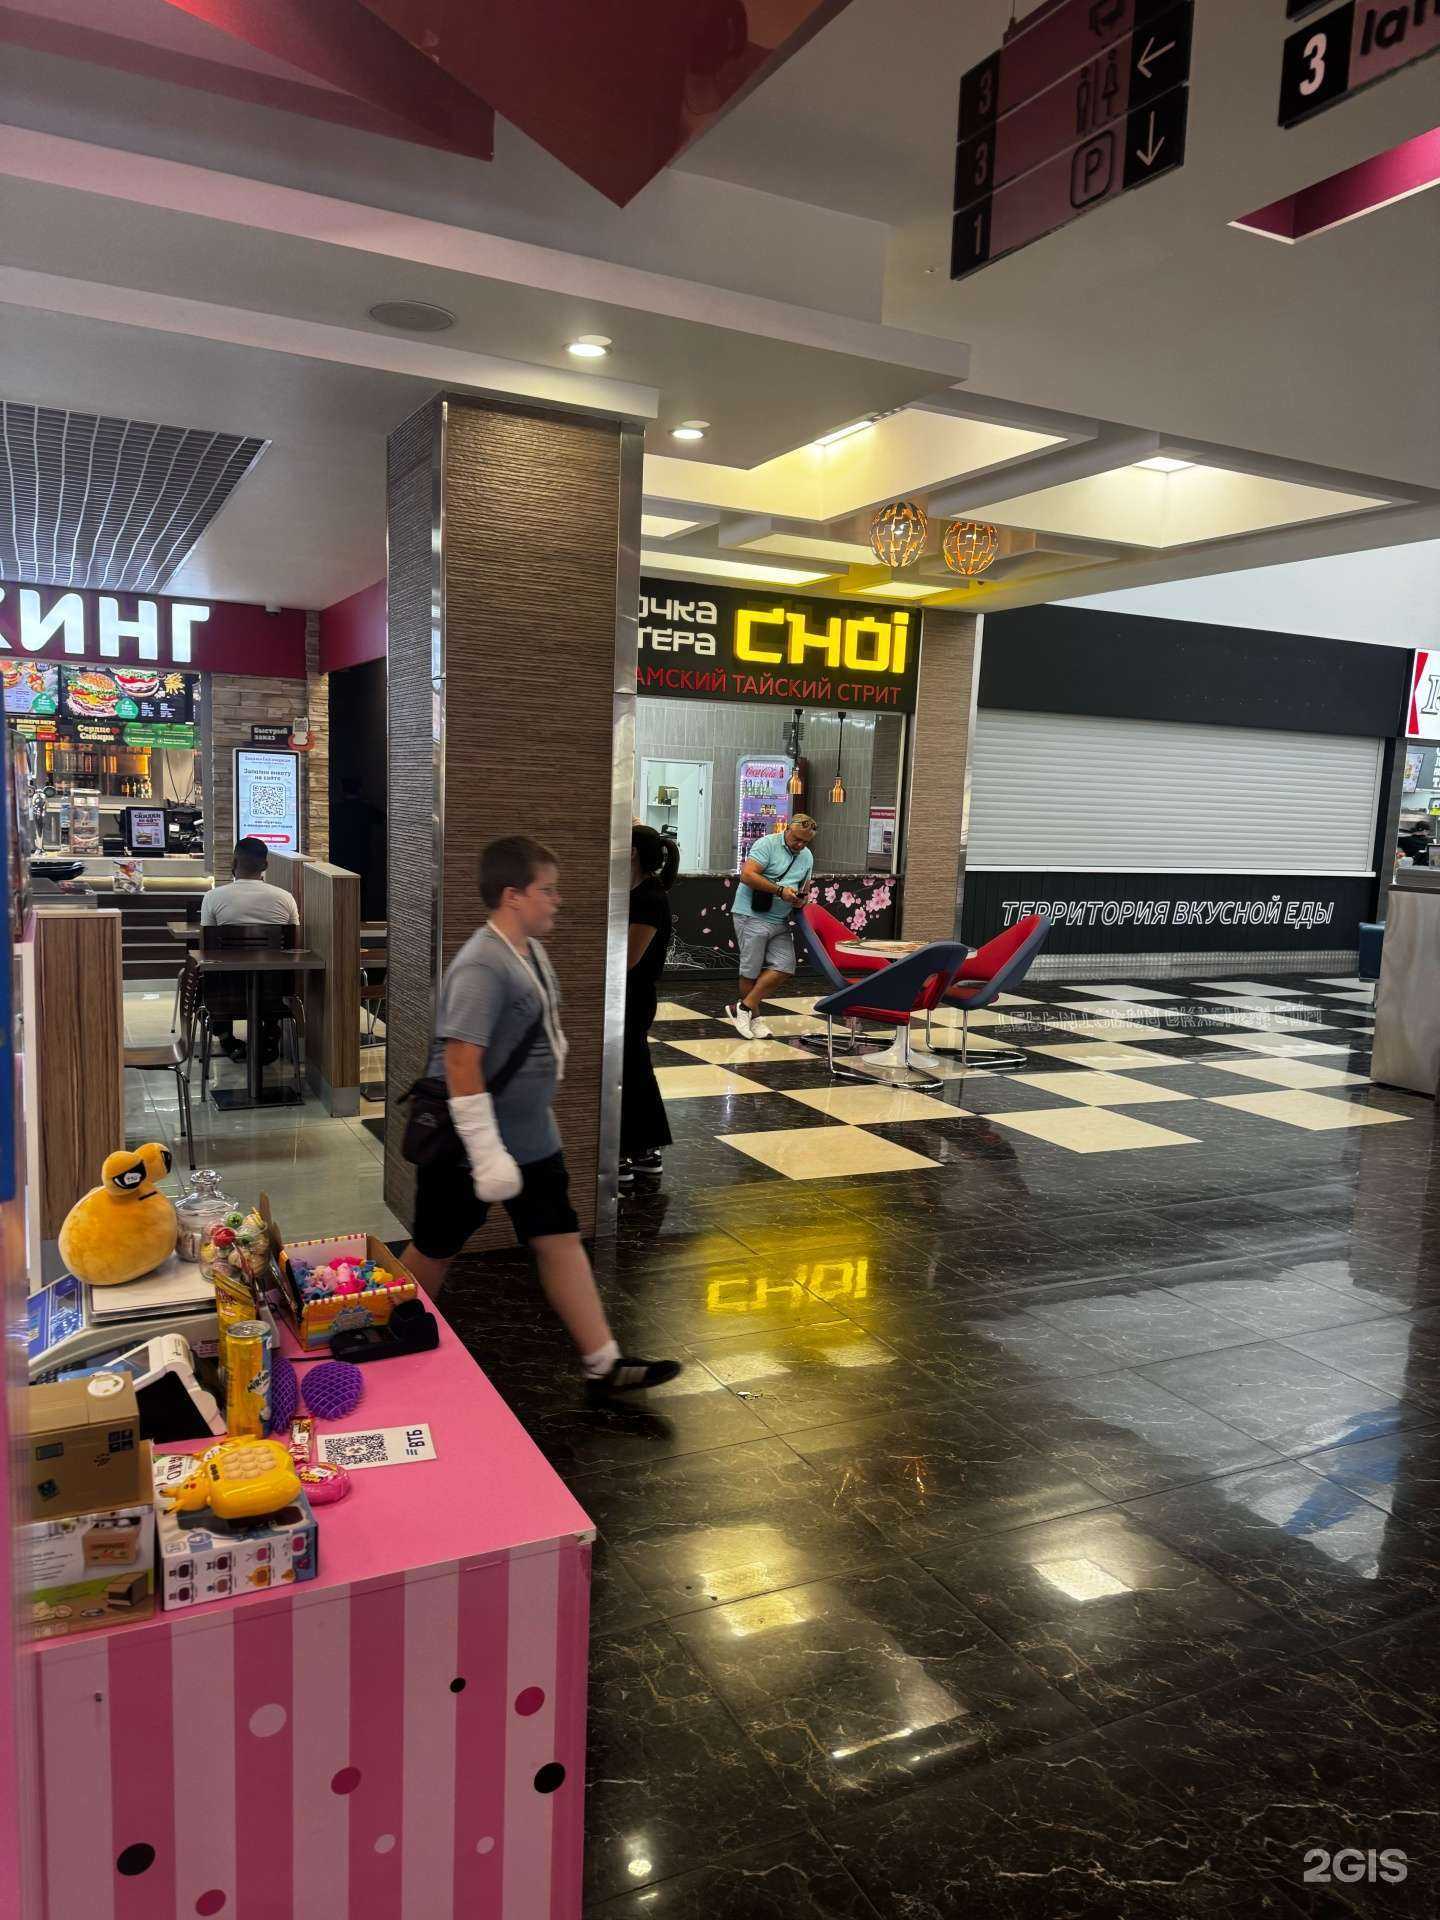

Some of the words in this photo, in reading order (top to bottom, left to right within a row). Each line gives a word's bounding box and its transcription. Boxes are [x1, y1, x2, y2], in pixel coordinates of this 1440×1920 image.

[1299, 33, 1327, 96] 3
[978, 69, 992, 115] 3
[973, 142, 988, 186] 3
[974, 213, 983, 257] 1
[0, 587, 210, 663] ИНГ
[731, 673, 832, 700] ТАЙСКИЙ
[837, 683, 902, 705] СТРИТ
[1002, 901, 1170, 927] ТЕРРИТОРИЯ
[1172, 895, 1282, 925] ВКУСНОЙ
[1284, 901, 1335, 930] ЕДЫ
[406, 1429, 426, 1449] ВТБ
